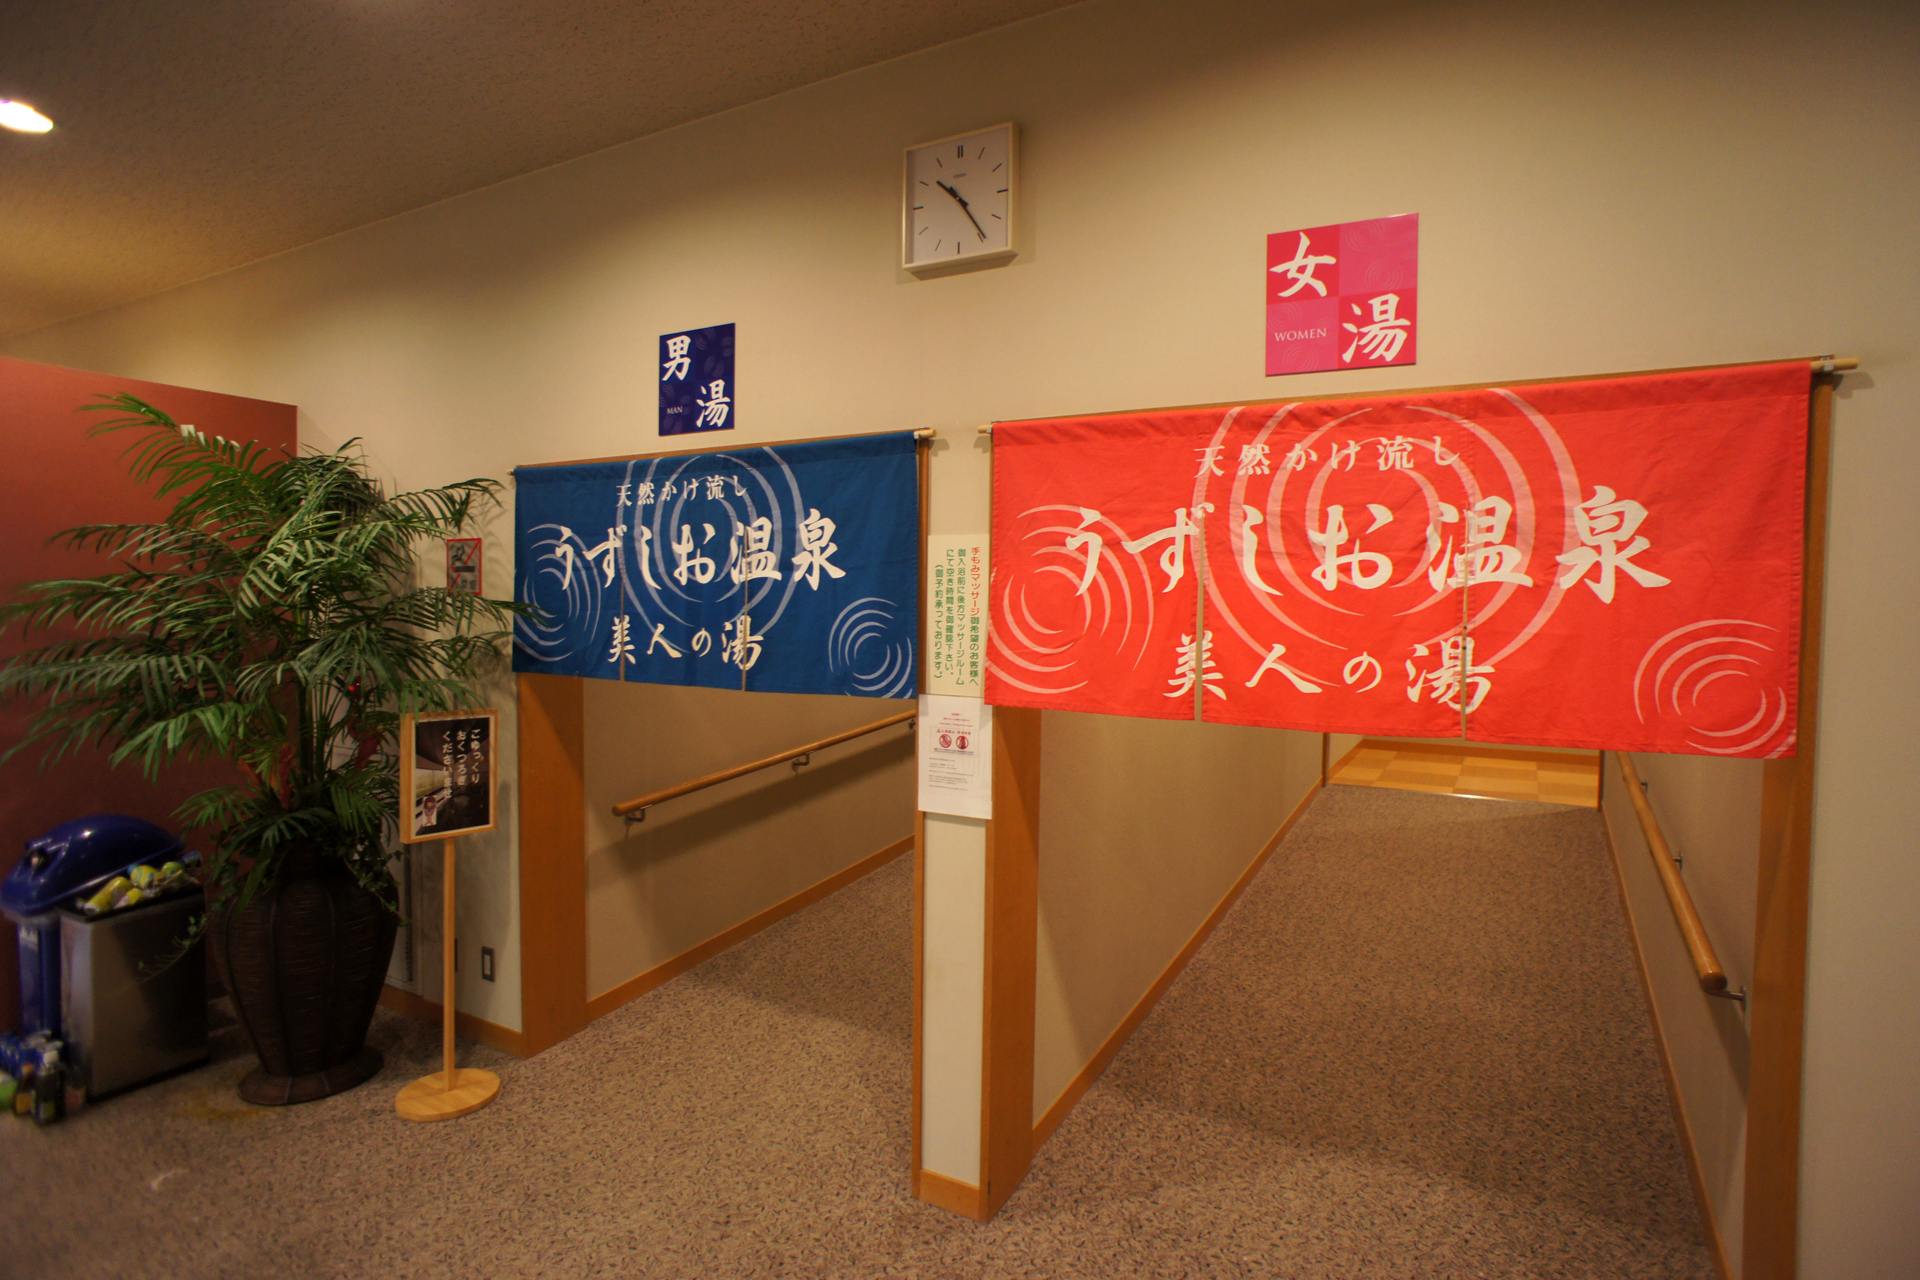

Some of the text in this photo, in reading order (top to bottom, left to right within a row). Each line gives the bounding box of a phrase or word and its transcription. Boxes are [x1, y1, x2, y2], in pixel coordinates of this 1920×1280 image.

[1274, 328, 1327, 342] WOMEN
[667, 406, 683, 415] MAN
[1193, 435, 1460, 478] 天然かけ流し
[615, 475, 747, 507] 天然かけ流し
[555, 508, 846, 591] うずしお温泉
[1065, 485, 1672, 604] うずしお温泉
[607, 614, 765, 671] 美人の湯
[1163, 629, 1496, 715] 美人の湯
